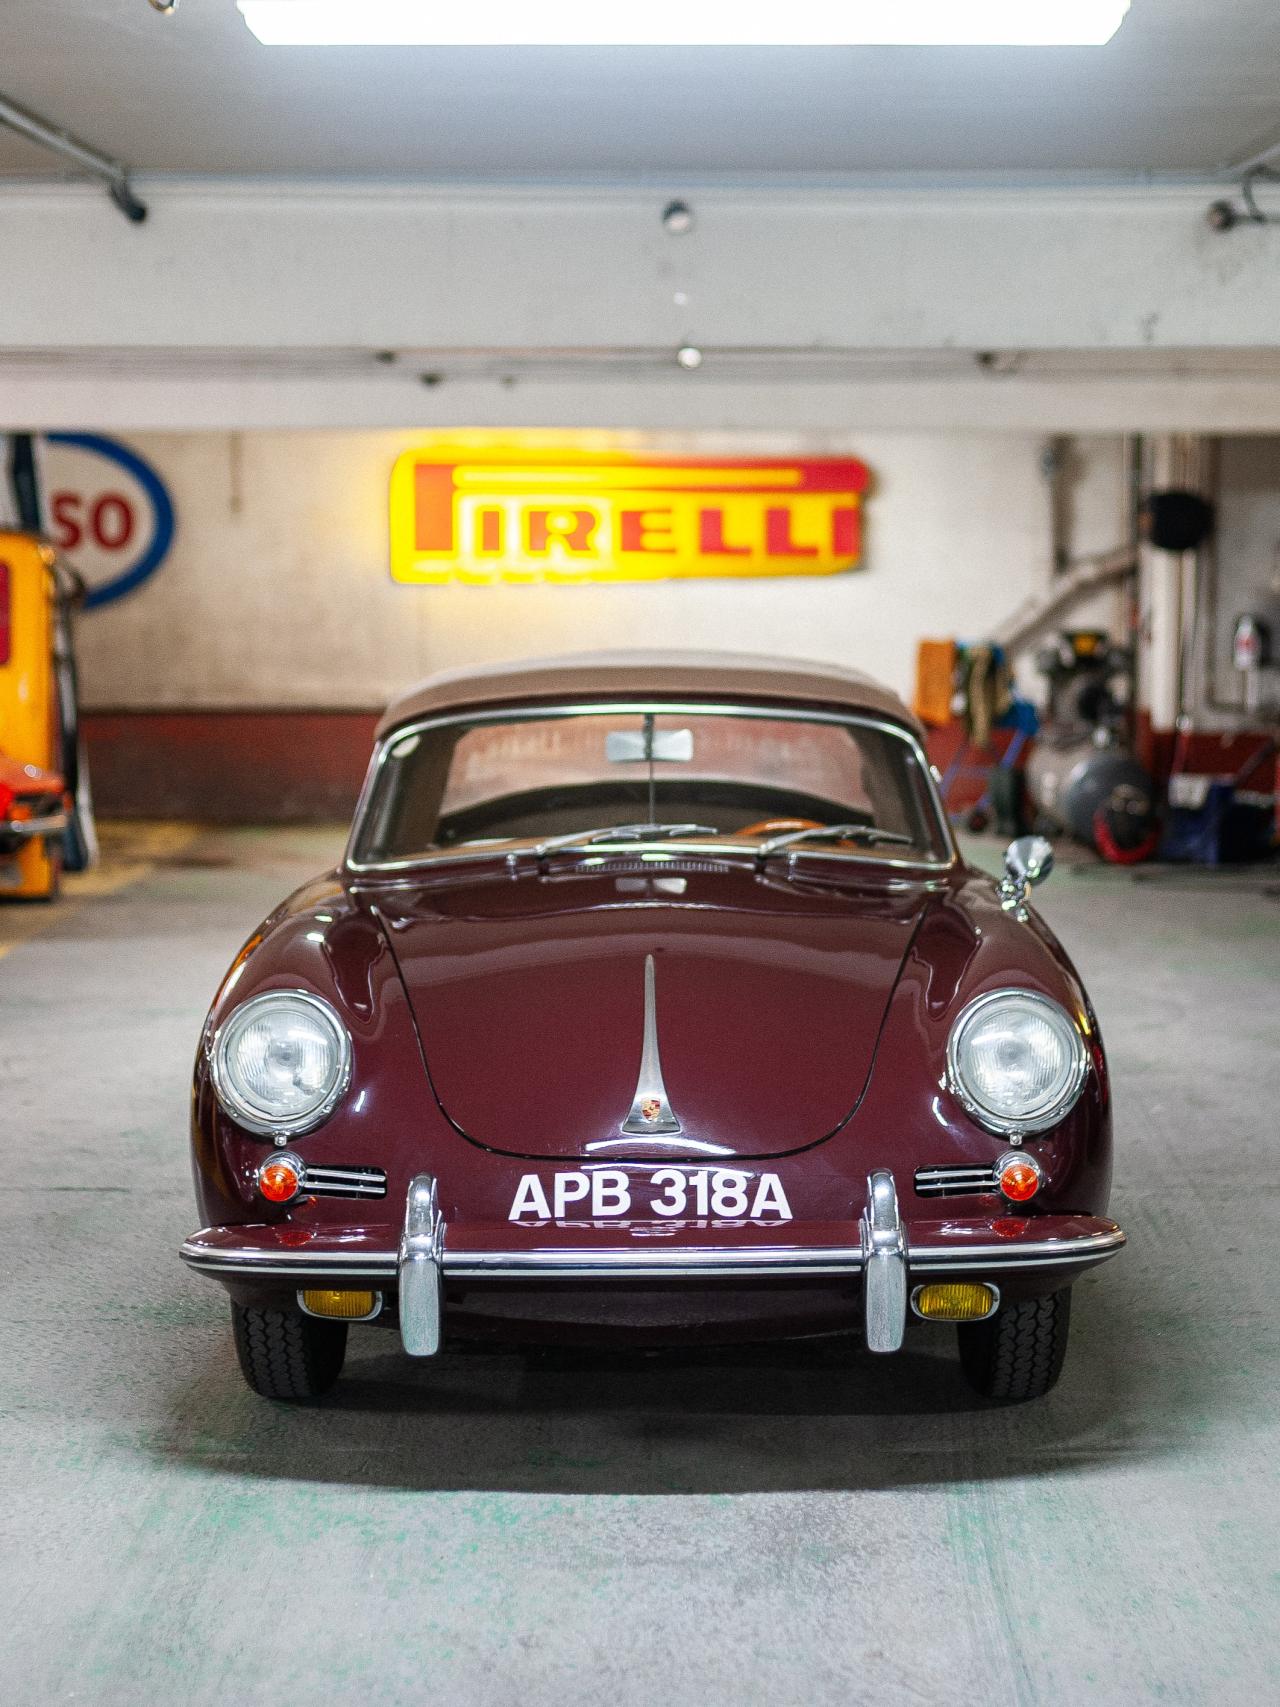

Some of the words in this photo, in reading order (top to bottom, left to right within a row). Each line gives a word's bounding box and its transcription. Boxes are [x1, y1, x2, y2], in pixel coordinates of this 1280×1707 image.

[413, 455, 870, 557] PIRELLI
[507, 1169, 632, 1221] APB
[649, 1169, 794, 1220] 318A
